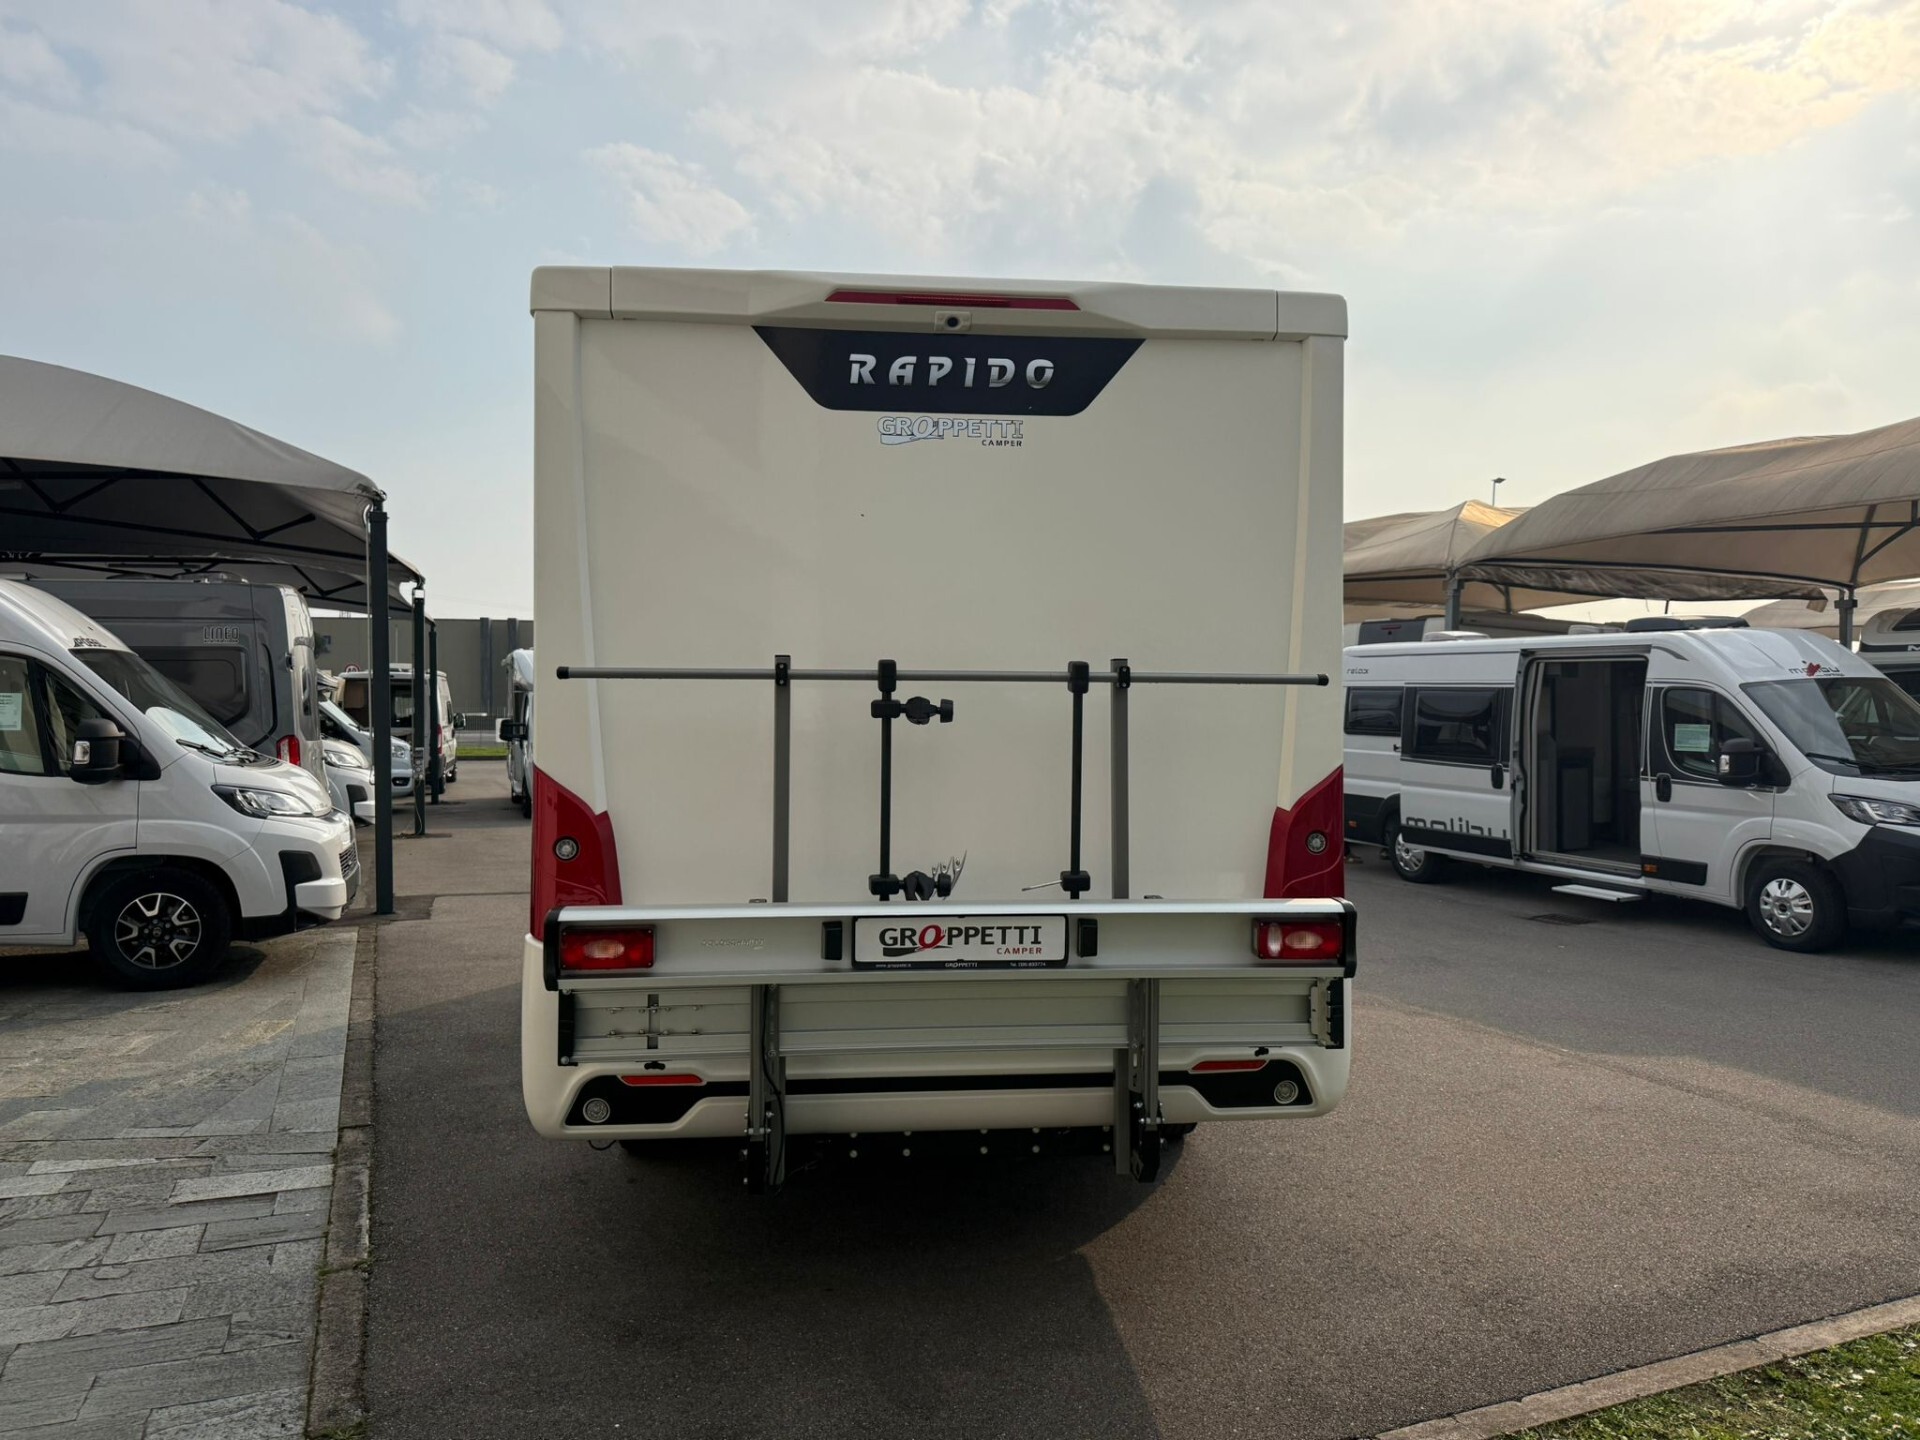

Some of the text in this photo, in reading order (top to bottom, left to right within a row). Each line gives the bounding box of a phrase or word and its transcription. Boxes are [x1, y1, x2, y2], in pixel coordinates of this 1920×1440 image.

[849, 353, 1055, 389] RAPIDO
[877, 415, 1024, 440] GROPPETTI
[981, 439, 1023, 447] CAMPER
[878, 924, 1042, 950] GROPPETTI
[996, 947, 1042, 955] CAMPER
